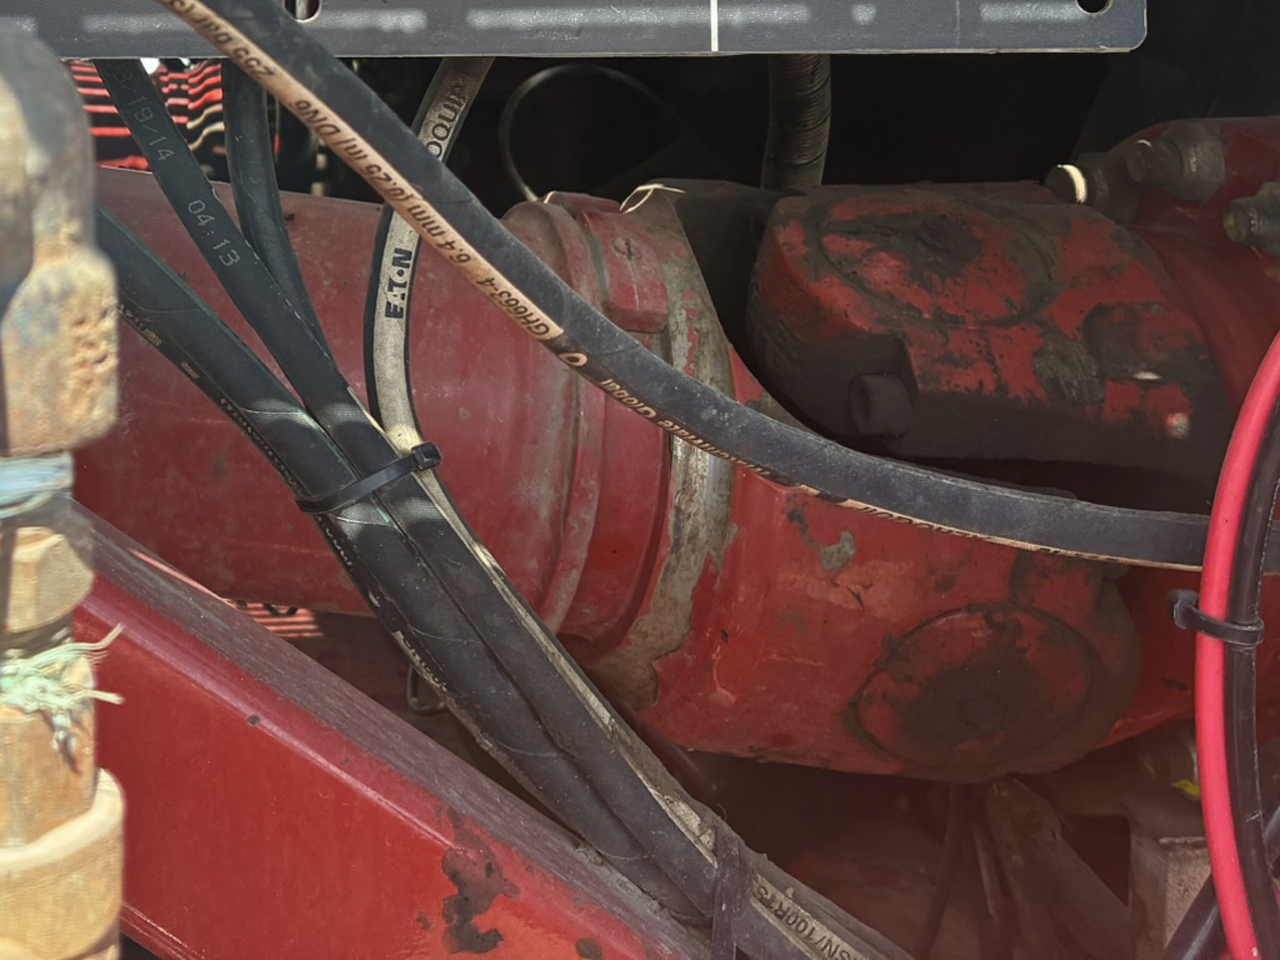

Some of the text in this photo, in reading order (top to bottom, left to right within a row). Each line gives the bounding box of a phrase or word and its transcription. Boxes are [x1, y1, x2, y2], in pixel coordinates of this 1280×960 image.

[295, 100, 341, 140] DN6
[407, 204, 446, 238] mm
[438, 240, 471, 265] 6.4
[476, 276, 550, 337] GH663-4
